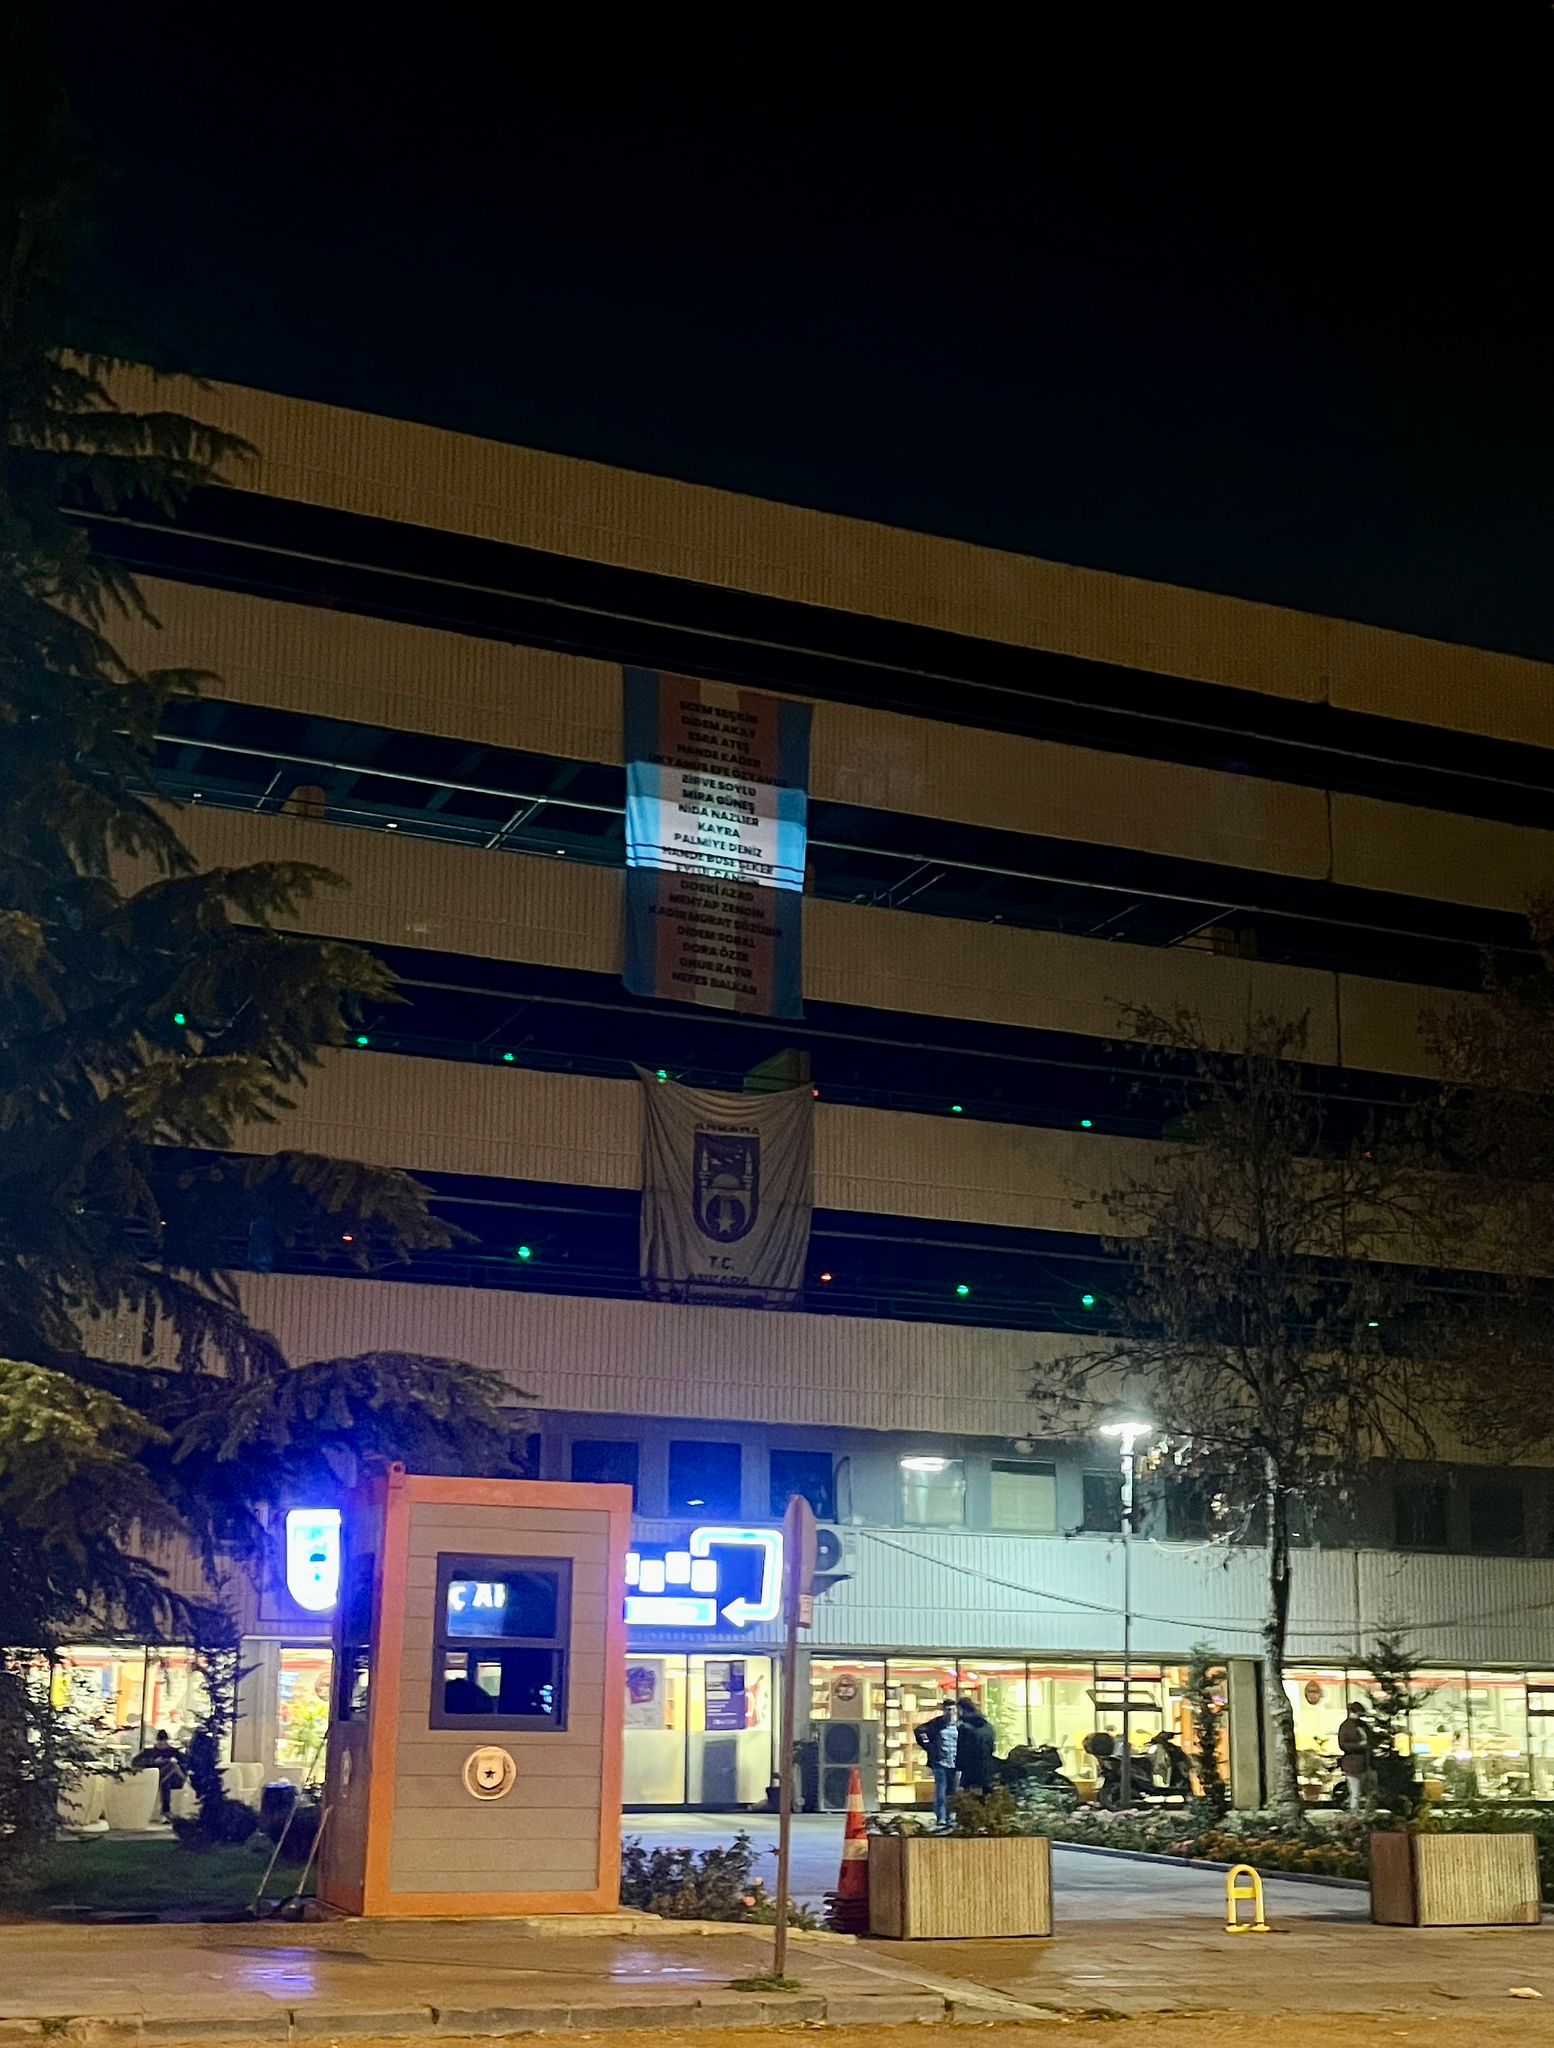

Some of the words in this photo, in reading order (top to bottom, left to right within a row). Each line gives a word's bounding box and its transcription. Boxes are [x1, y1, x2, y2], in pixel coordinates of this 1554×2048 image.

[678, 803, 709, 817] NİDA
[697, 822, 741, 838] KAYRA
[729, 842, 762, 858] DENİZ
